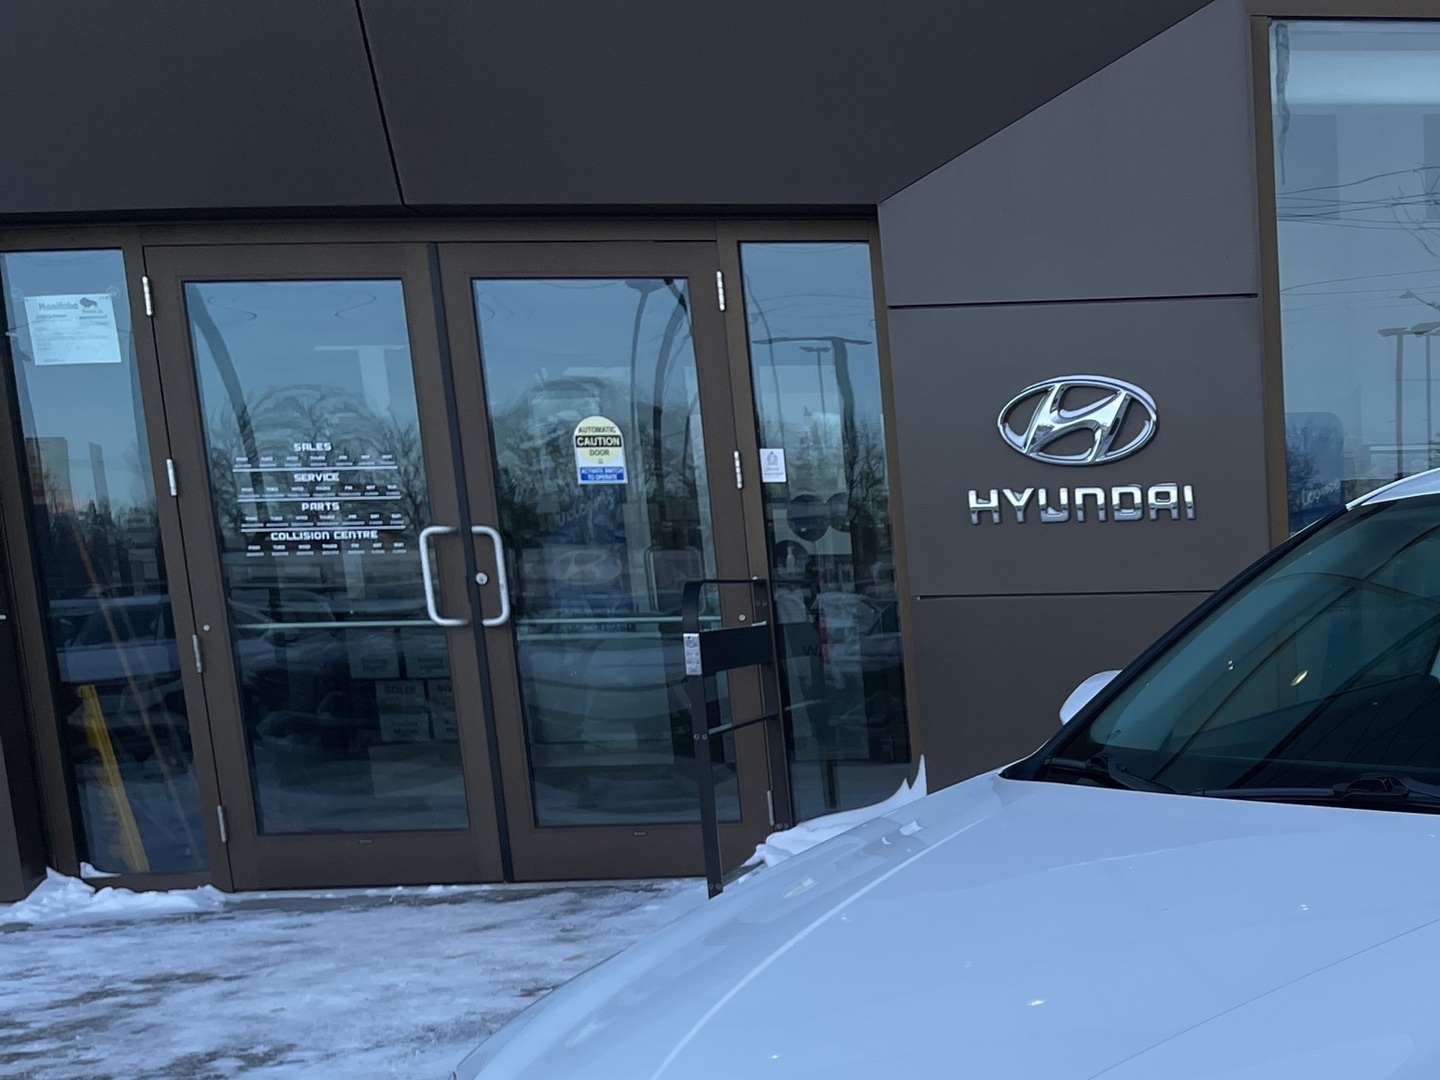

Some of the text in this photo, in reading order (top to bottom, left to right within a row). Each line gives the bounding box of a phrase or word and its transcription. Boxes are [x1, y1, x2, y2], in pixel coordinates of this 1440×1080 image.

[38, 302, 79, 311] Manitoba
[577, 437, 620, 446] CAUTION
[293, 442, 332, 452] SALES
[293, 473, 340, 482] SERVICE
[301, 502, 340, 511] PARTS
[968, 482, 1196, 525] HYUNDAI
[270, 530, 379, 541] COLLISION CENTRE
